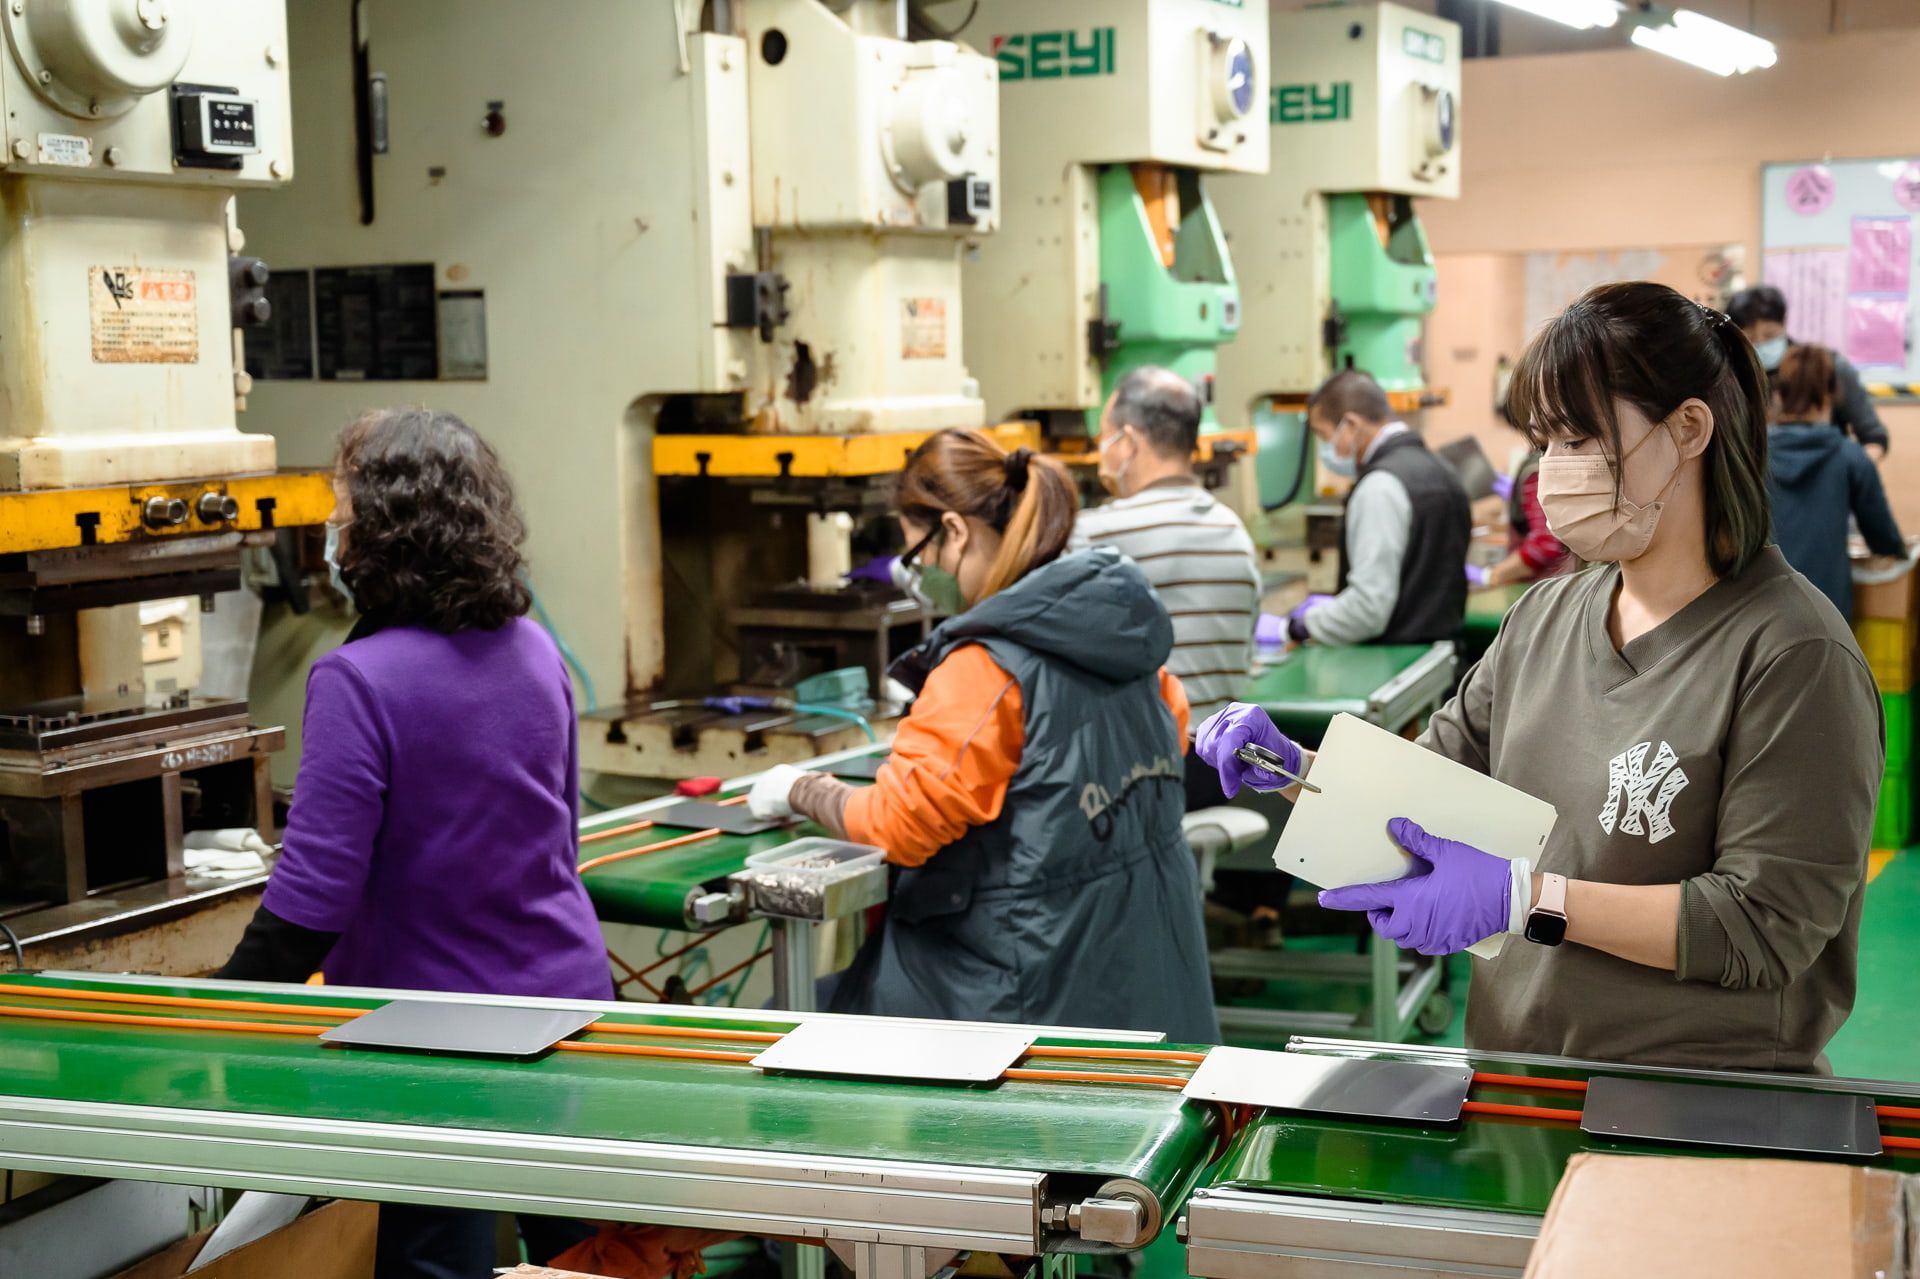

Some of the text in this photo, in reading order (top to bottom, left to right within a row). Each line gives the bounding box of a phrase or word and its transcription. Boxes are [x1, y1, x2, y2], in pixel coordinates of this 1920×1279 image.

[992, 27, 1115, 81] SEYI
[1270, 80, 1351, 124] EYI
[1598, 740, 1690, 844] NY
